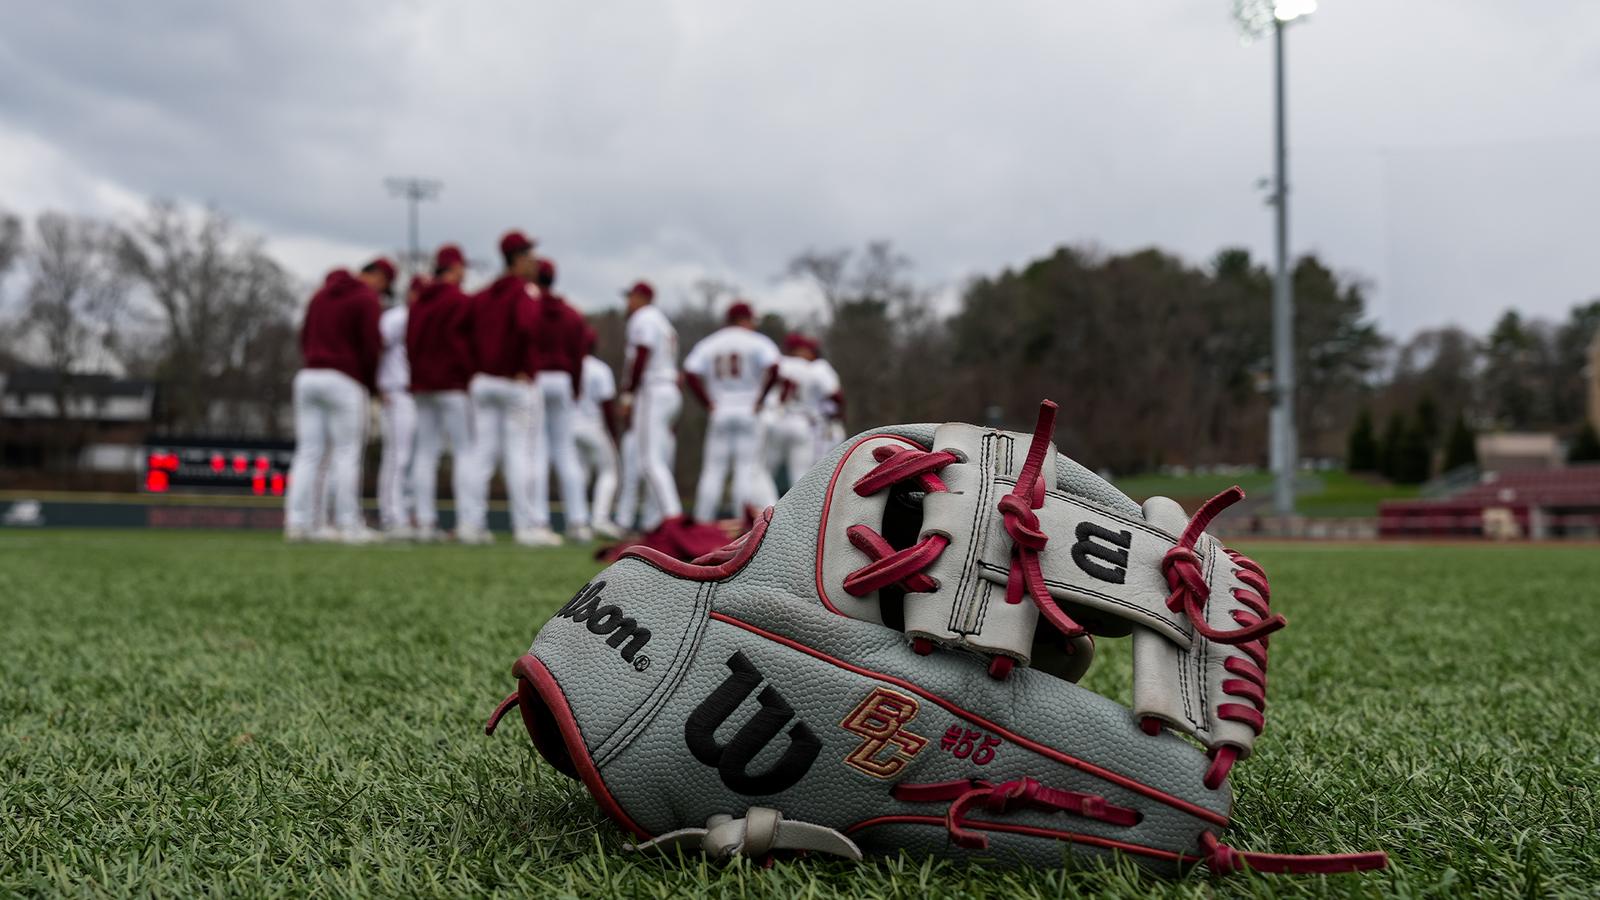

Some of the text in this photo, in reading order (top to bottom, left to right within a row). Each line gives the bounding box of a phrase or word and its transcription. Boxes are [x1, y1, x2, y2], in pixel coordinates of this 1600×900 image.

[684, 650, 824, 797] W
[839, 686, 930, 779] BC
[940, 723, 1003, 766] #55
